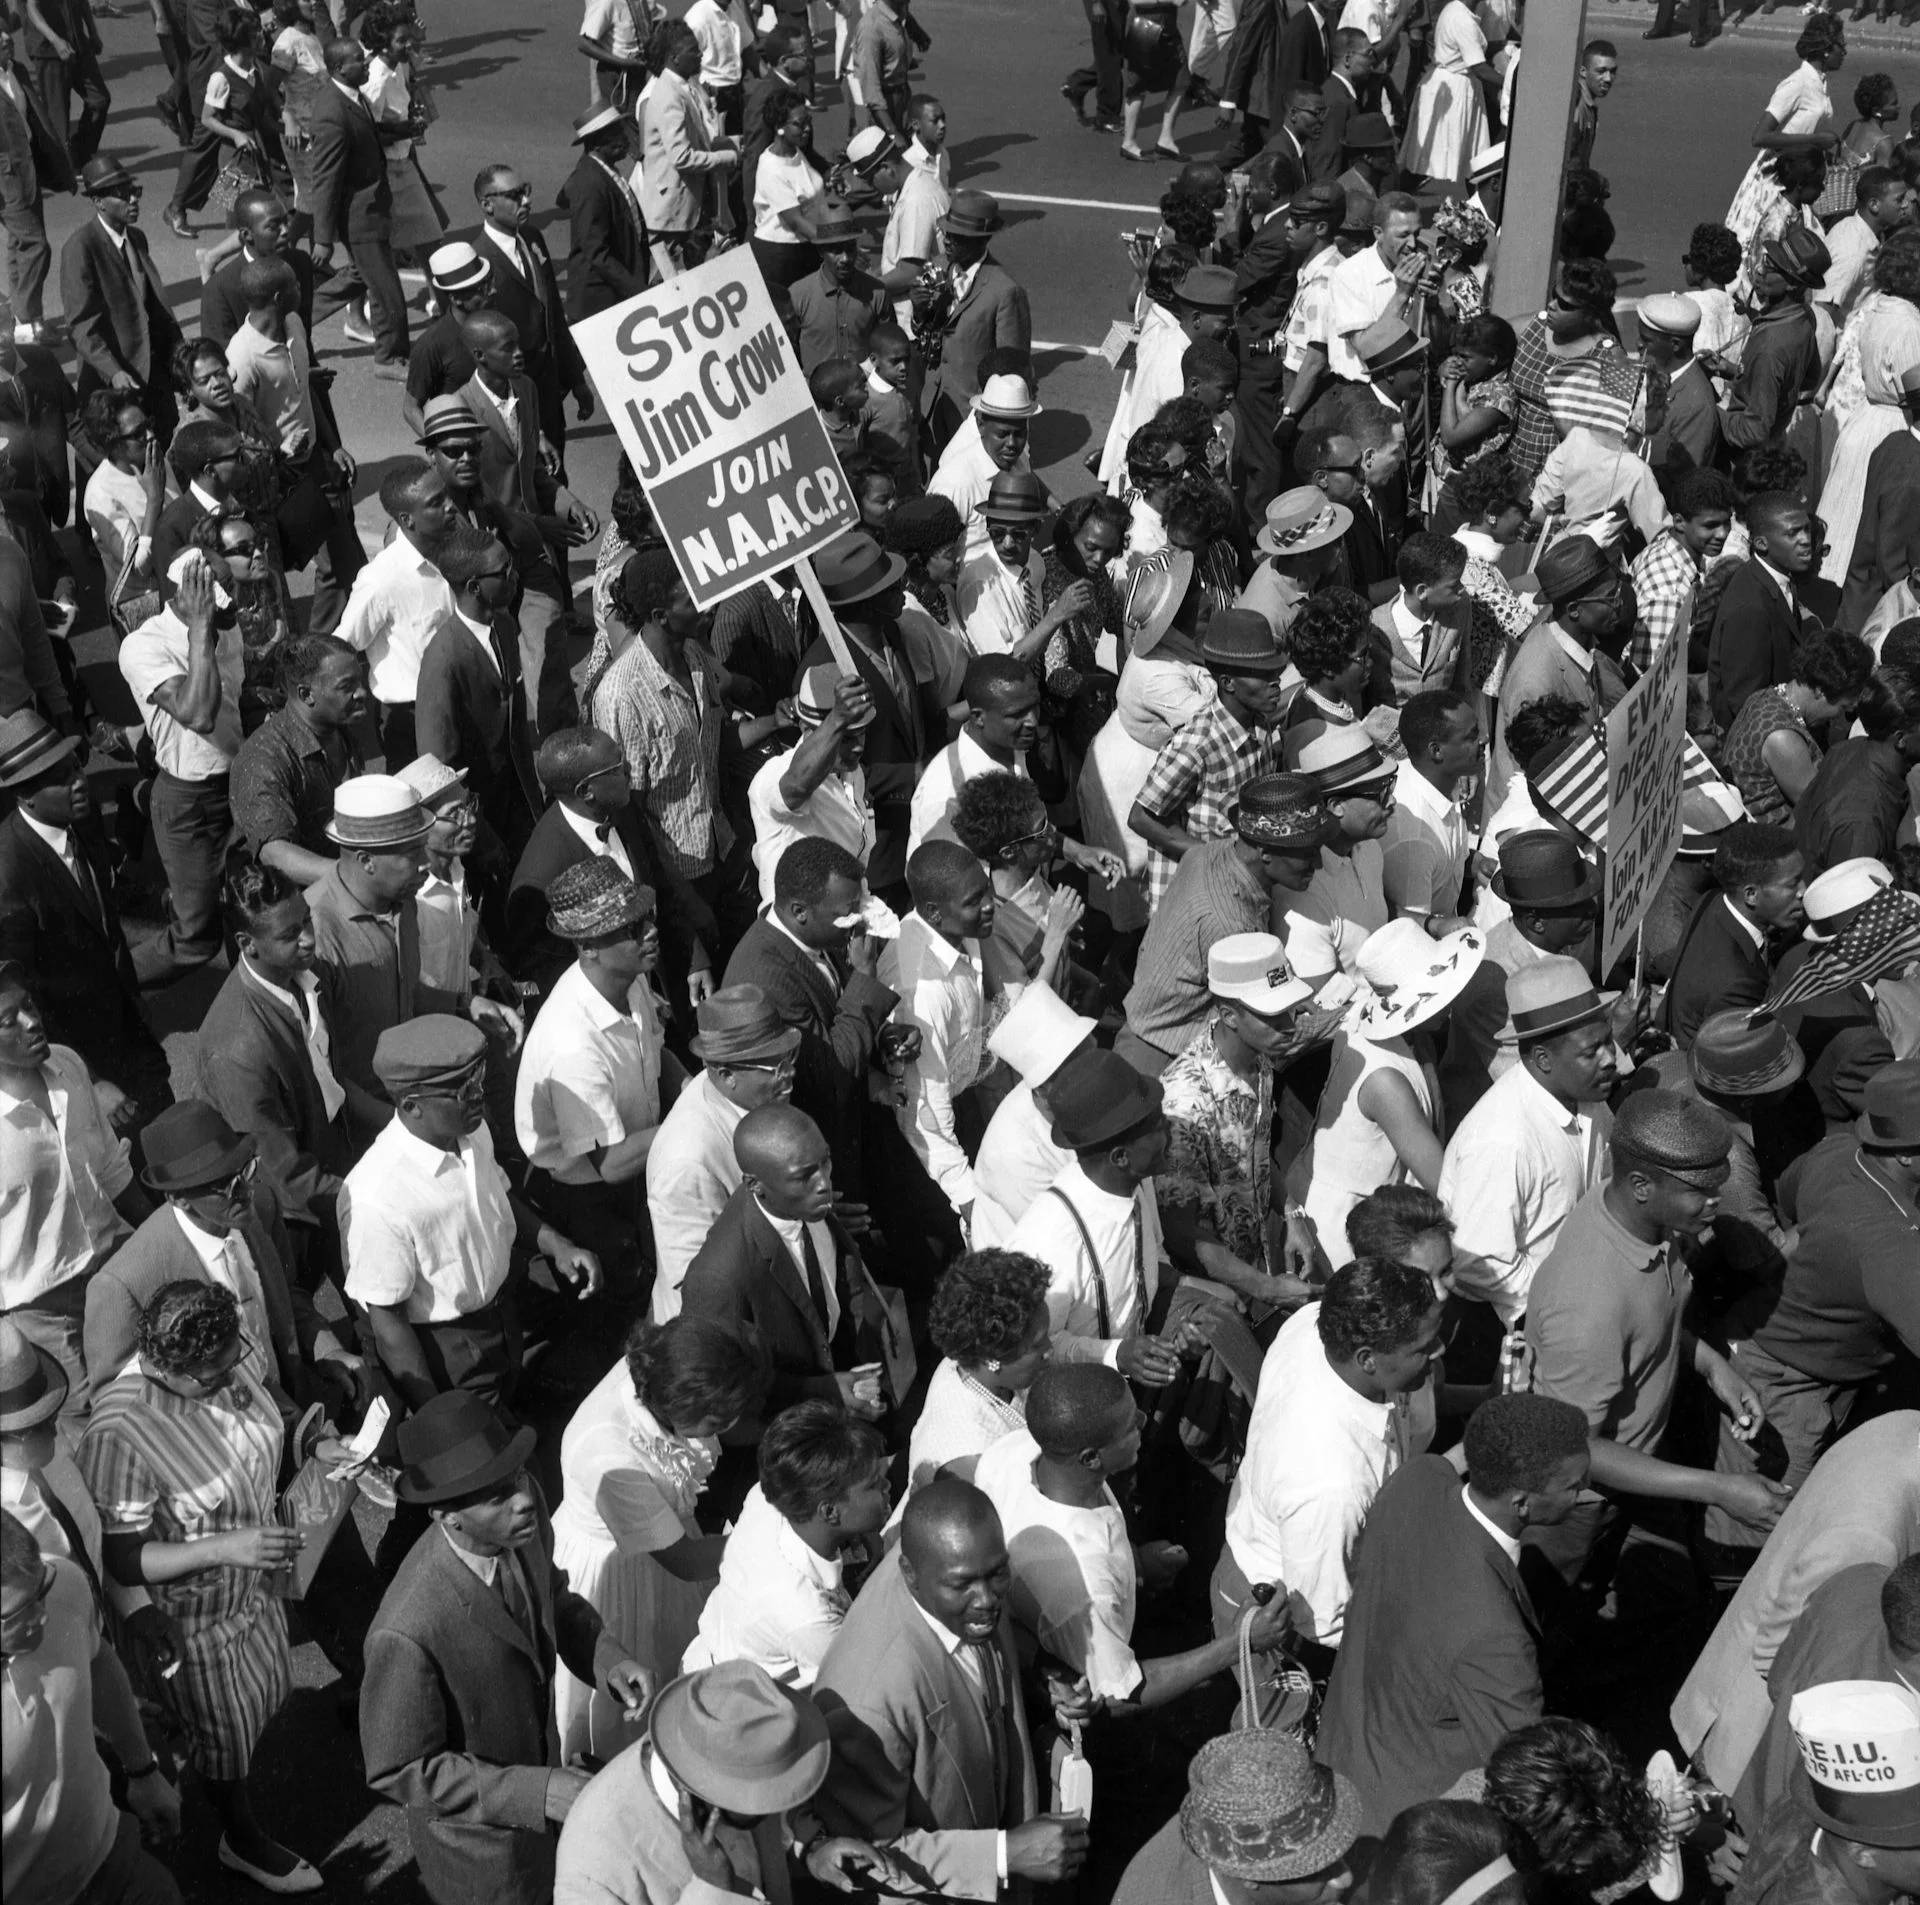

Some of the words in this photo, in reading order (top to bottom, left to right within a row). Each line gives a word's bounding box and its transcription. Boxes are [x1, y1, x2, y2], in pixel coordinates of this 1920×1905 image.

[616, 281, 747, 381] STOP
[626, 391, 712, 479] Jim
[707, 434, 792, 508] JOIN
[682, 466, 847, 586] N.A.A.C.P.
[1628, 623, 1679, 746] EVERS
[1614, 722, 1657, 808] DIED
[1609, 850, 1636, 911] Join
[1611, 872, 1644, 945] FOR
[1834, 1767, 1896, 1782] AFL-CIO
